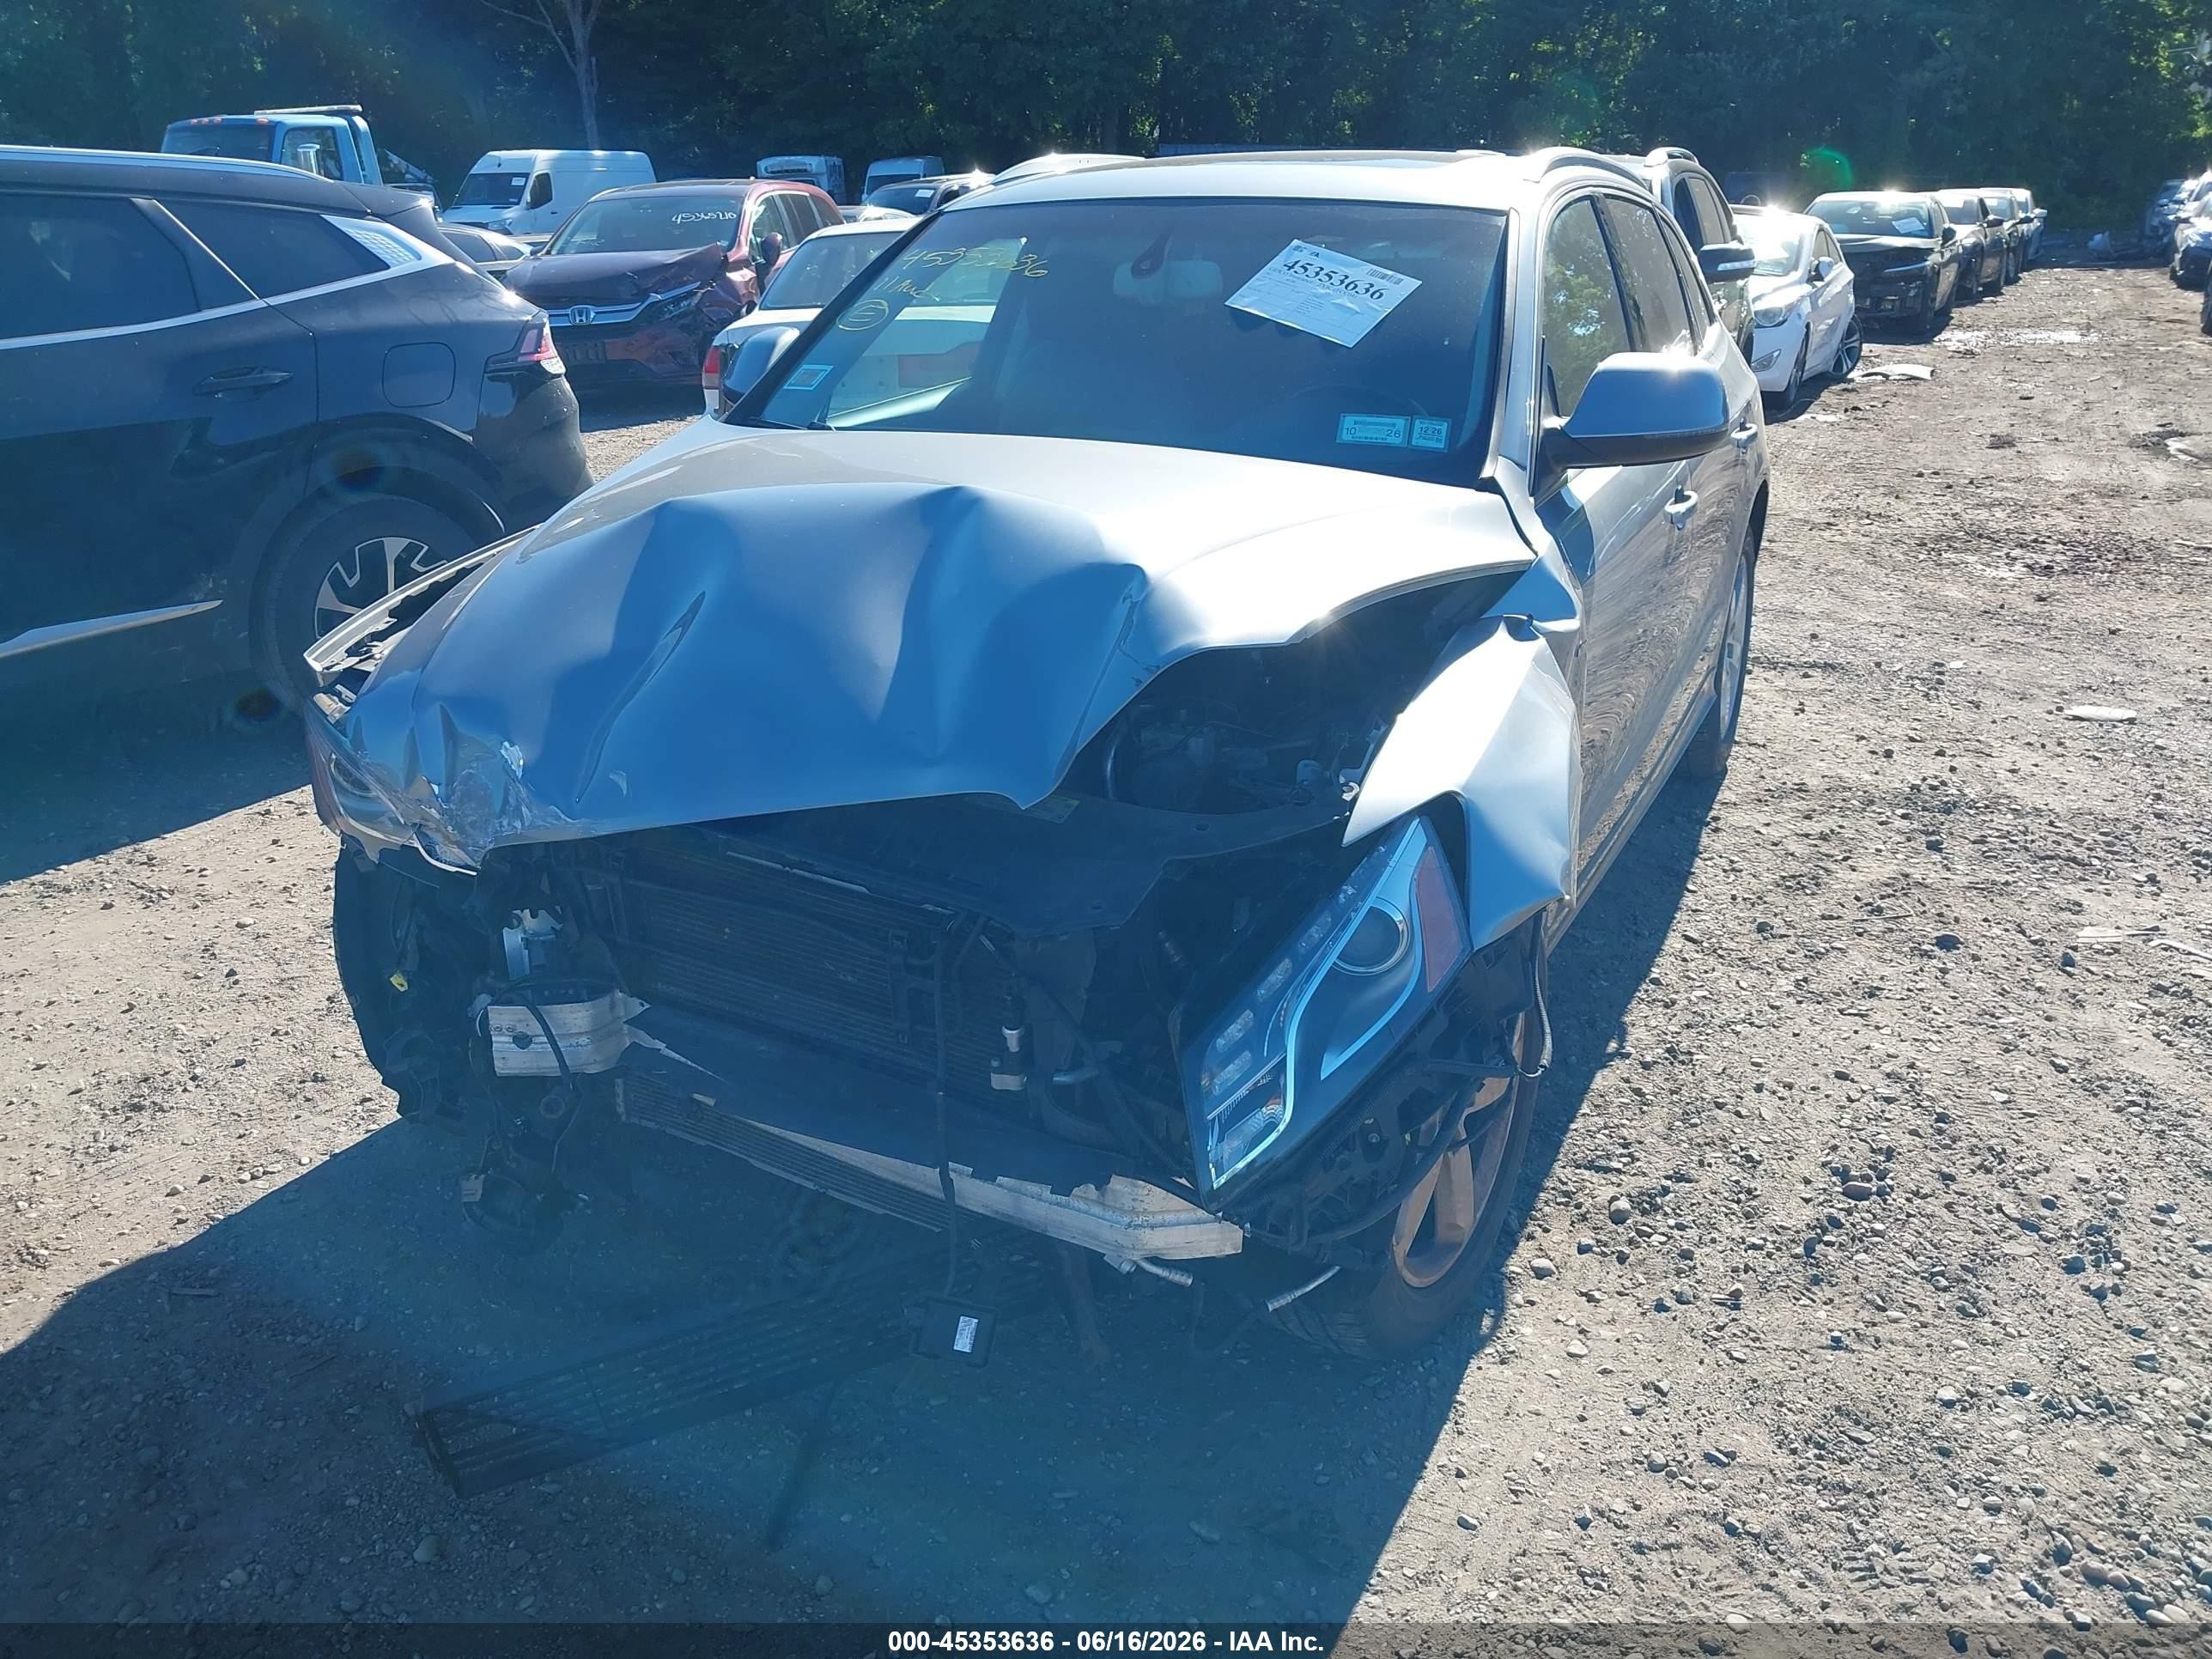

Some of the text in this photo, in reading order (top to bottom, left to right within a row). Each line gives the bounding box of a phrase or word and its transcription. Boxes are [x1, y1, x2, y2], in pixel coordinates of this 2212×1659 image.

[1282, 258, 1389, 301] 45353636
[1346, 426, 1357, 436] 10
[1385, 428, 1401, 439] 26
